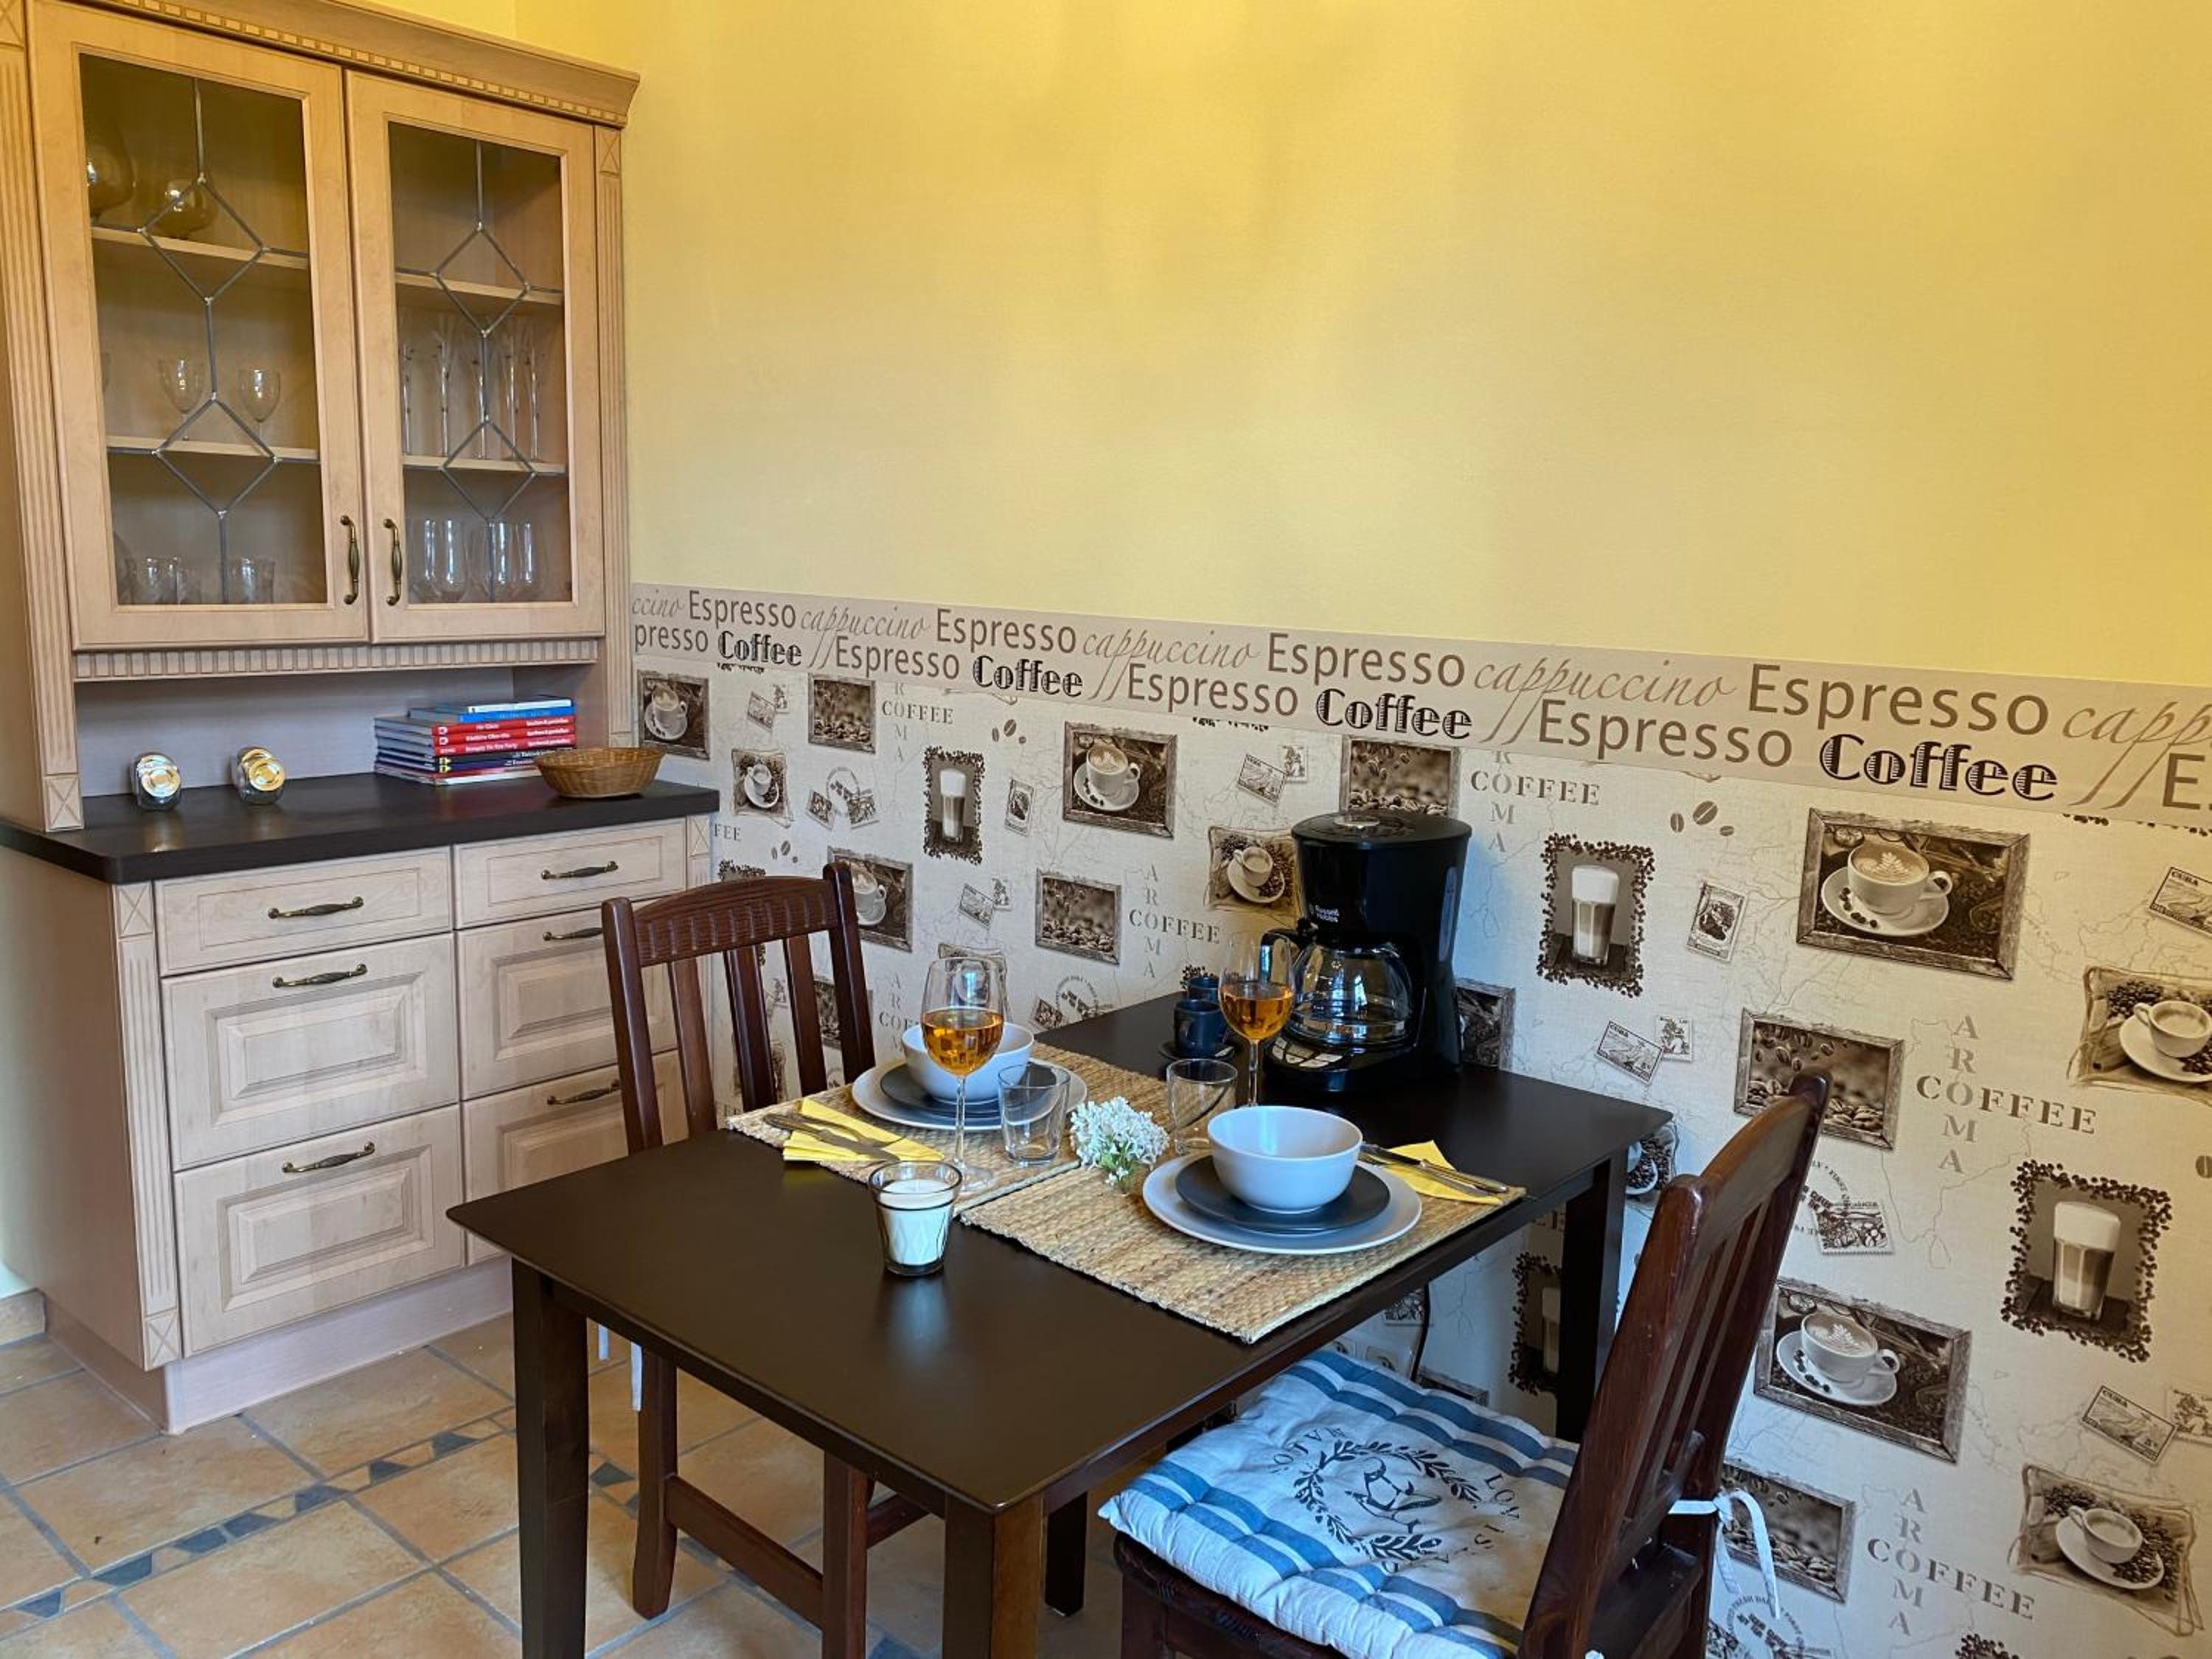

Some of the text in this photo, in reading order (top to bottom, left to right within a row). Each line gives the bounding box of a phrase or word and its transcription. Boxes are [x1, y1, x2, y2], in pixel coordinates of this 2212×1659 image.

[689, 589, 796, 629] Espresso
[801, 605, 929, 668] cappuccino
[936, 608, 1077, 653] Espresso
[1082, 627, 1259, 701] cappuccino
[1267, 632, 1465, 686] Espresso
[1473, 657, 1737, 745] cappuccino
[1748, 663, 2048, 731] Espresso
[717, 630, 803, 667] Coffee
[835, 635, 960, 679] Espresso
[973, 654, 1083, 698] Coffee
[1127, 663, 1299, 717] Espresso
[1315, 687, 1472, 740] Coffee
[1538, 698, 1792, 768] Espresso
[1818, 733, 2058, 801] Coffee
[882, 700, 953, 725] COFFEE
[1470, 770, 1601, 806] COFFEE
[1128, 908, 1220, 945] COFFEE
[1916, 1075, 2097, 1135] COFFEE
[1867, 1537, 2036, 1621] COFFEE
